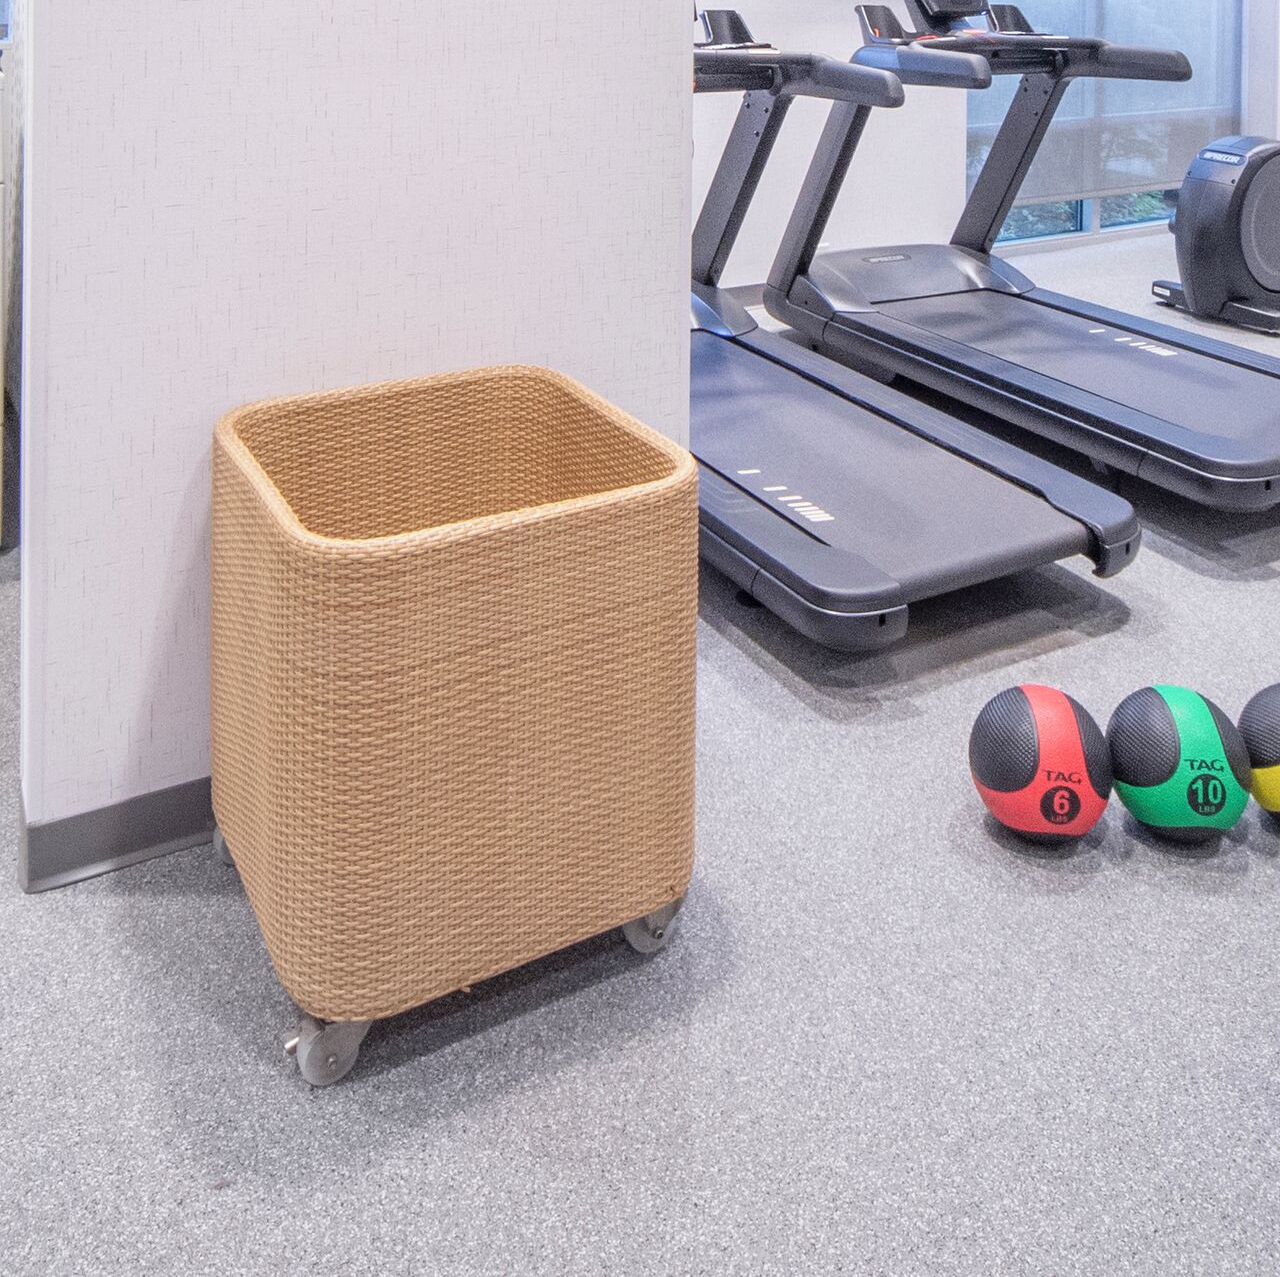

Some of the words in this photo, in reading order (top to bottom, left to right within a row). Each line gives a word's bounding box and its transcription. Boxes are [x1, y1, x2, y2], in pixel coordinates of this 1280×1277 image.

[1184, 759, 1225, 772] TAG
[1043, 770, 1082, 785] TAG
[1191, 778, 1222, 804] 10
[1053, 789, 1070, 815] 6
[1199, 805, 1216, 813] LBS
